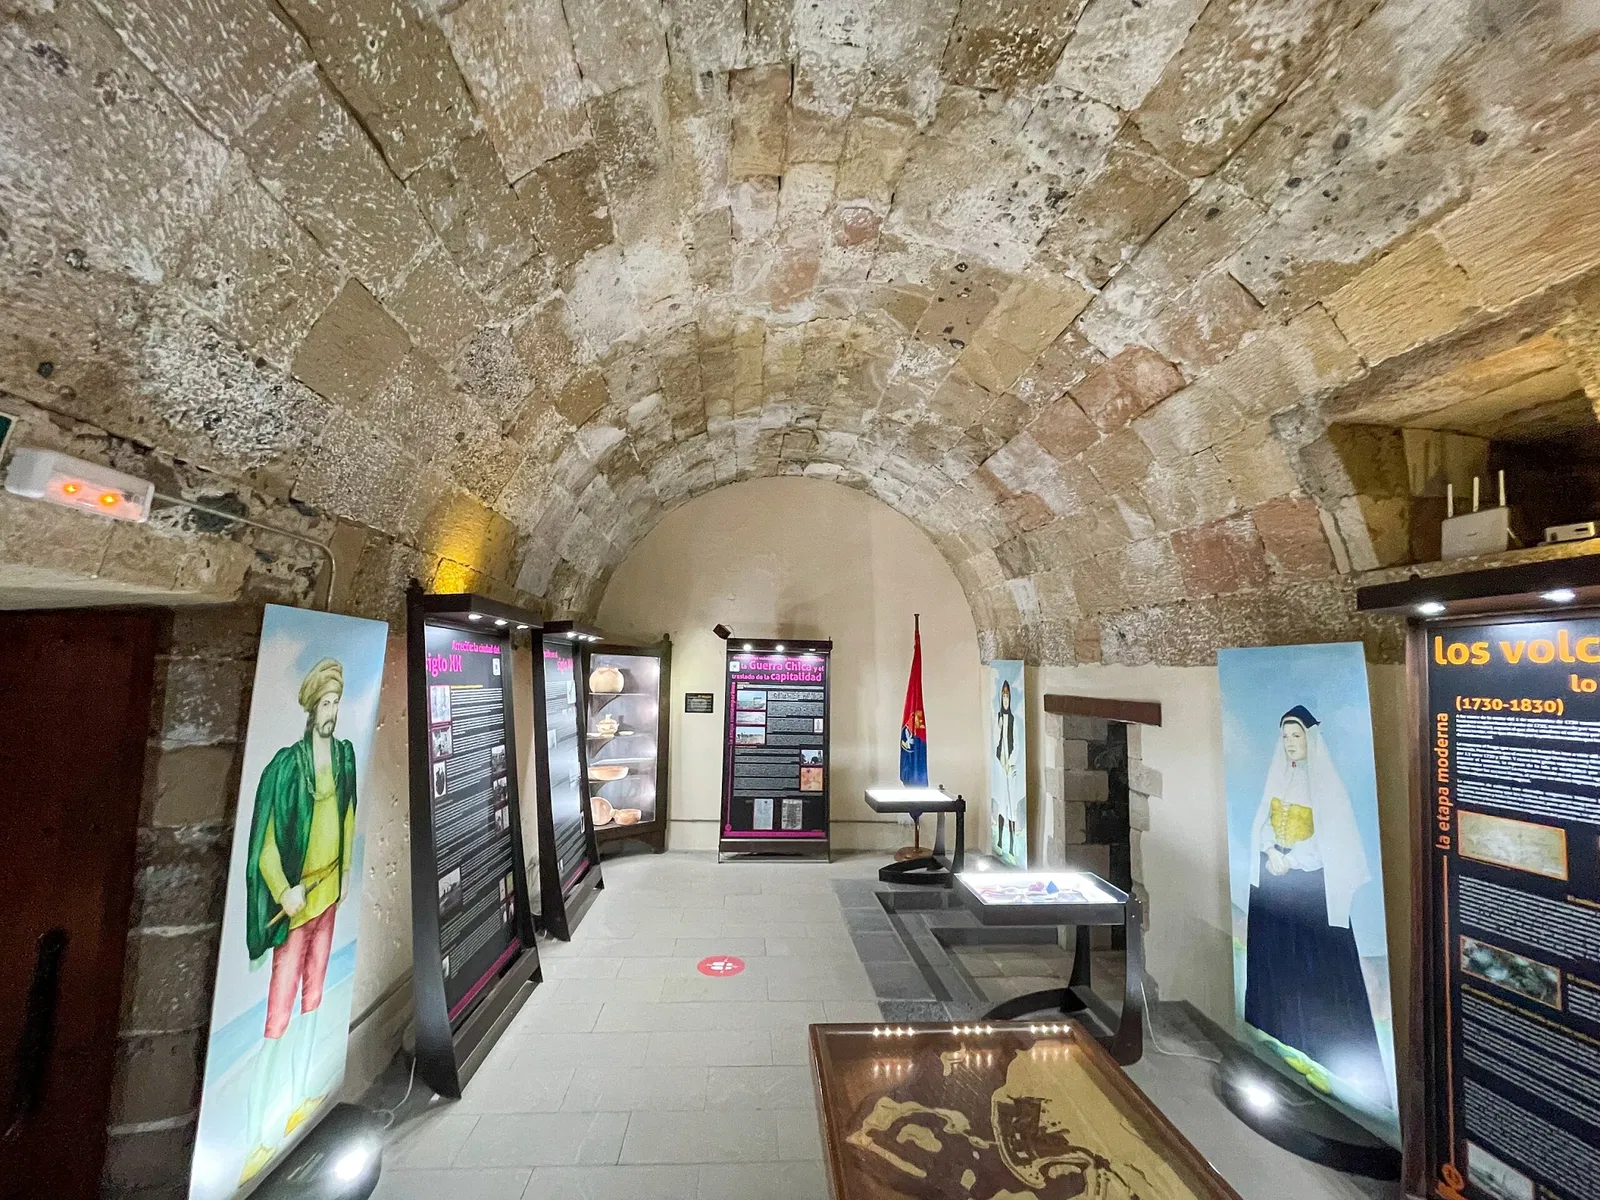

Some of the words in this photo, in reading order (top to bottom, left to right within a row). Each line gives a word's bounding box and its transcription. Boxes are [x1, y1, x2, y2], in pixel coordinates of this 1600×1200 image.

[1434, 635, 1491, 665] los
[1499, 629, 1600, 665] volc
[749, 660, 783, 671] Guerra
[785, 661, 812, 671] Chica
[770, 672, 822, 683] capitalidad
[1455, 695, 1565, 717] (1730-1830)
[1433, 712, 1449, 783] moderna
[1436, 786, 1454, 832] etapa
[1435, 834, 1451, 850] la
